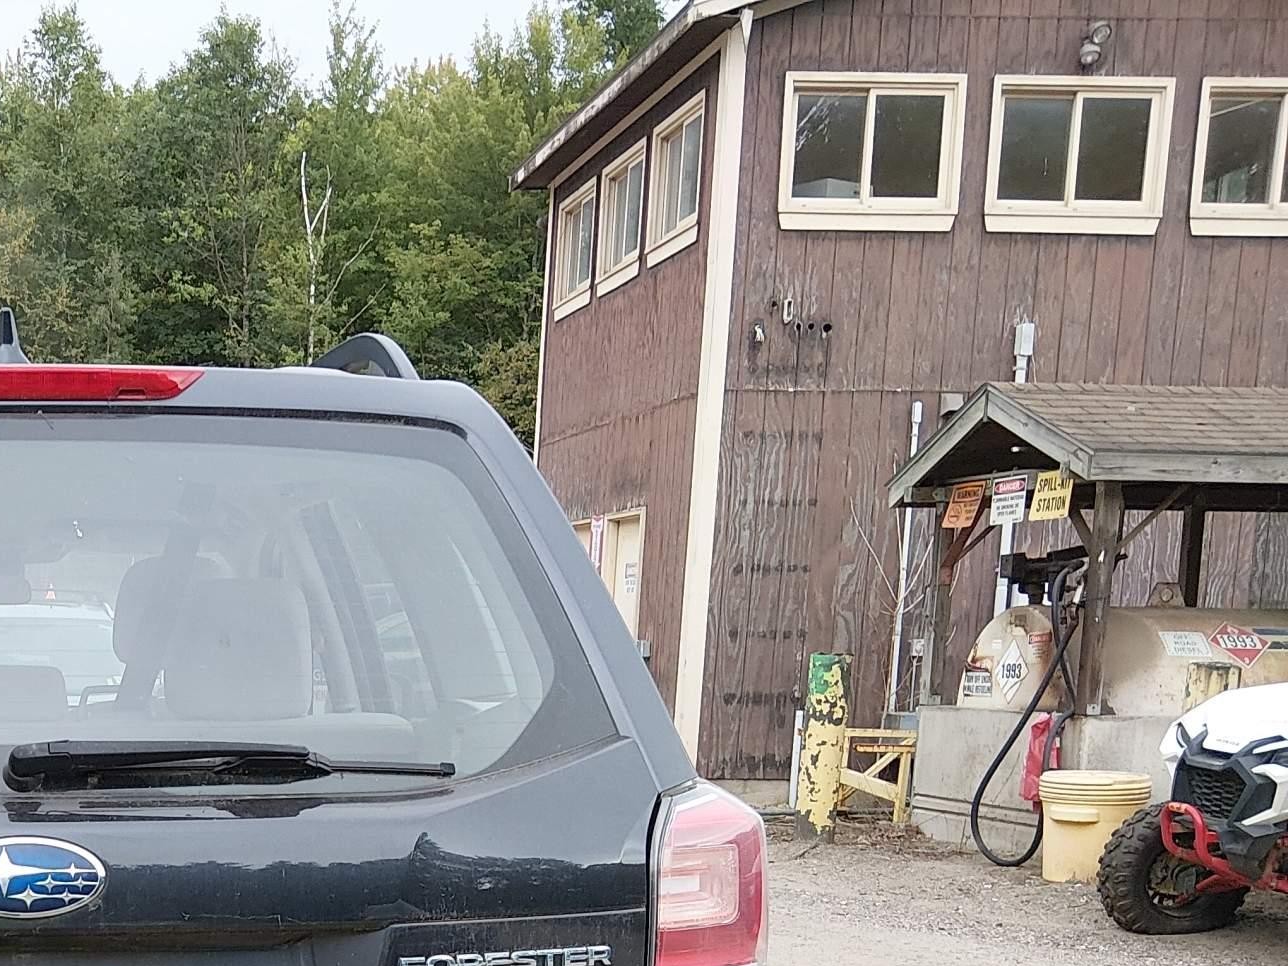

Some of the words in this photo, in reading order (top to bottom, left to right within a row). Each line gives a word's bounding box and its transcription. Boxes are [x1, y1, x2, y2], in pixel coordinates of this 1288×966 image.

[1036, 496, 1067, 512] STATION
[1220, 635, 1257, 648] 1993
[1002, 663, 1022, 678] 1993
